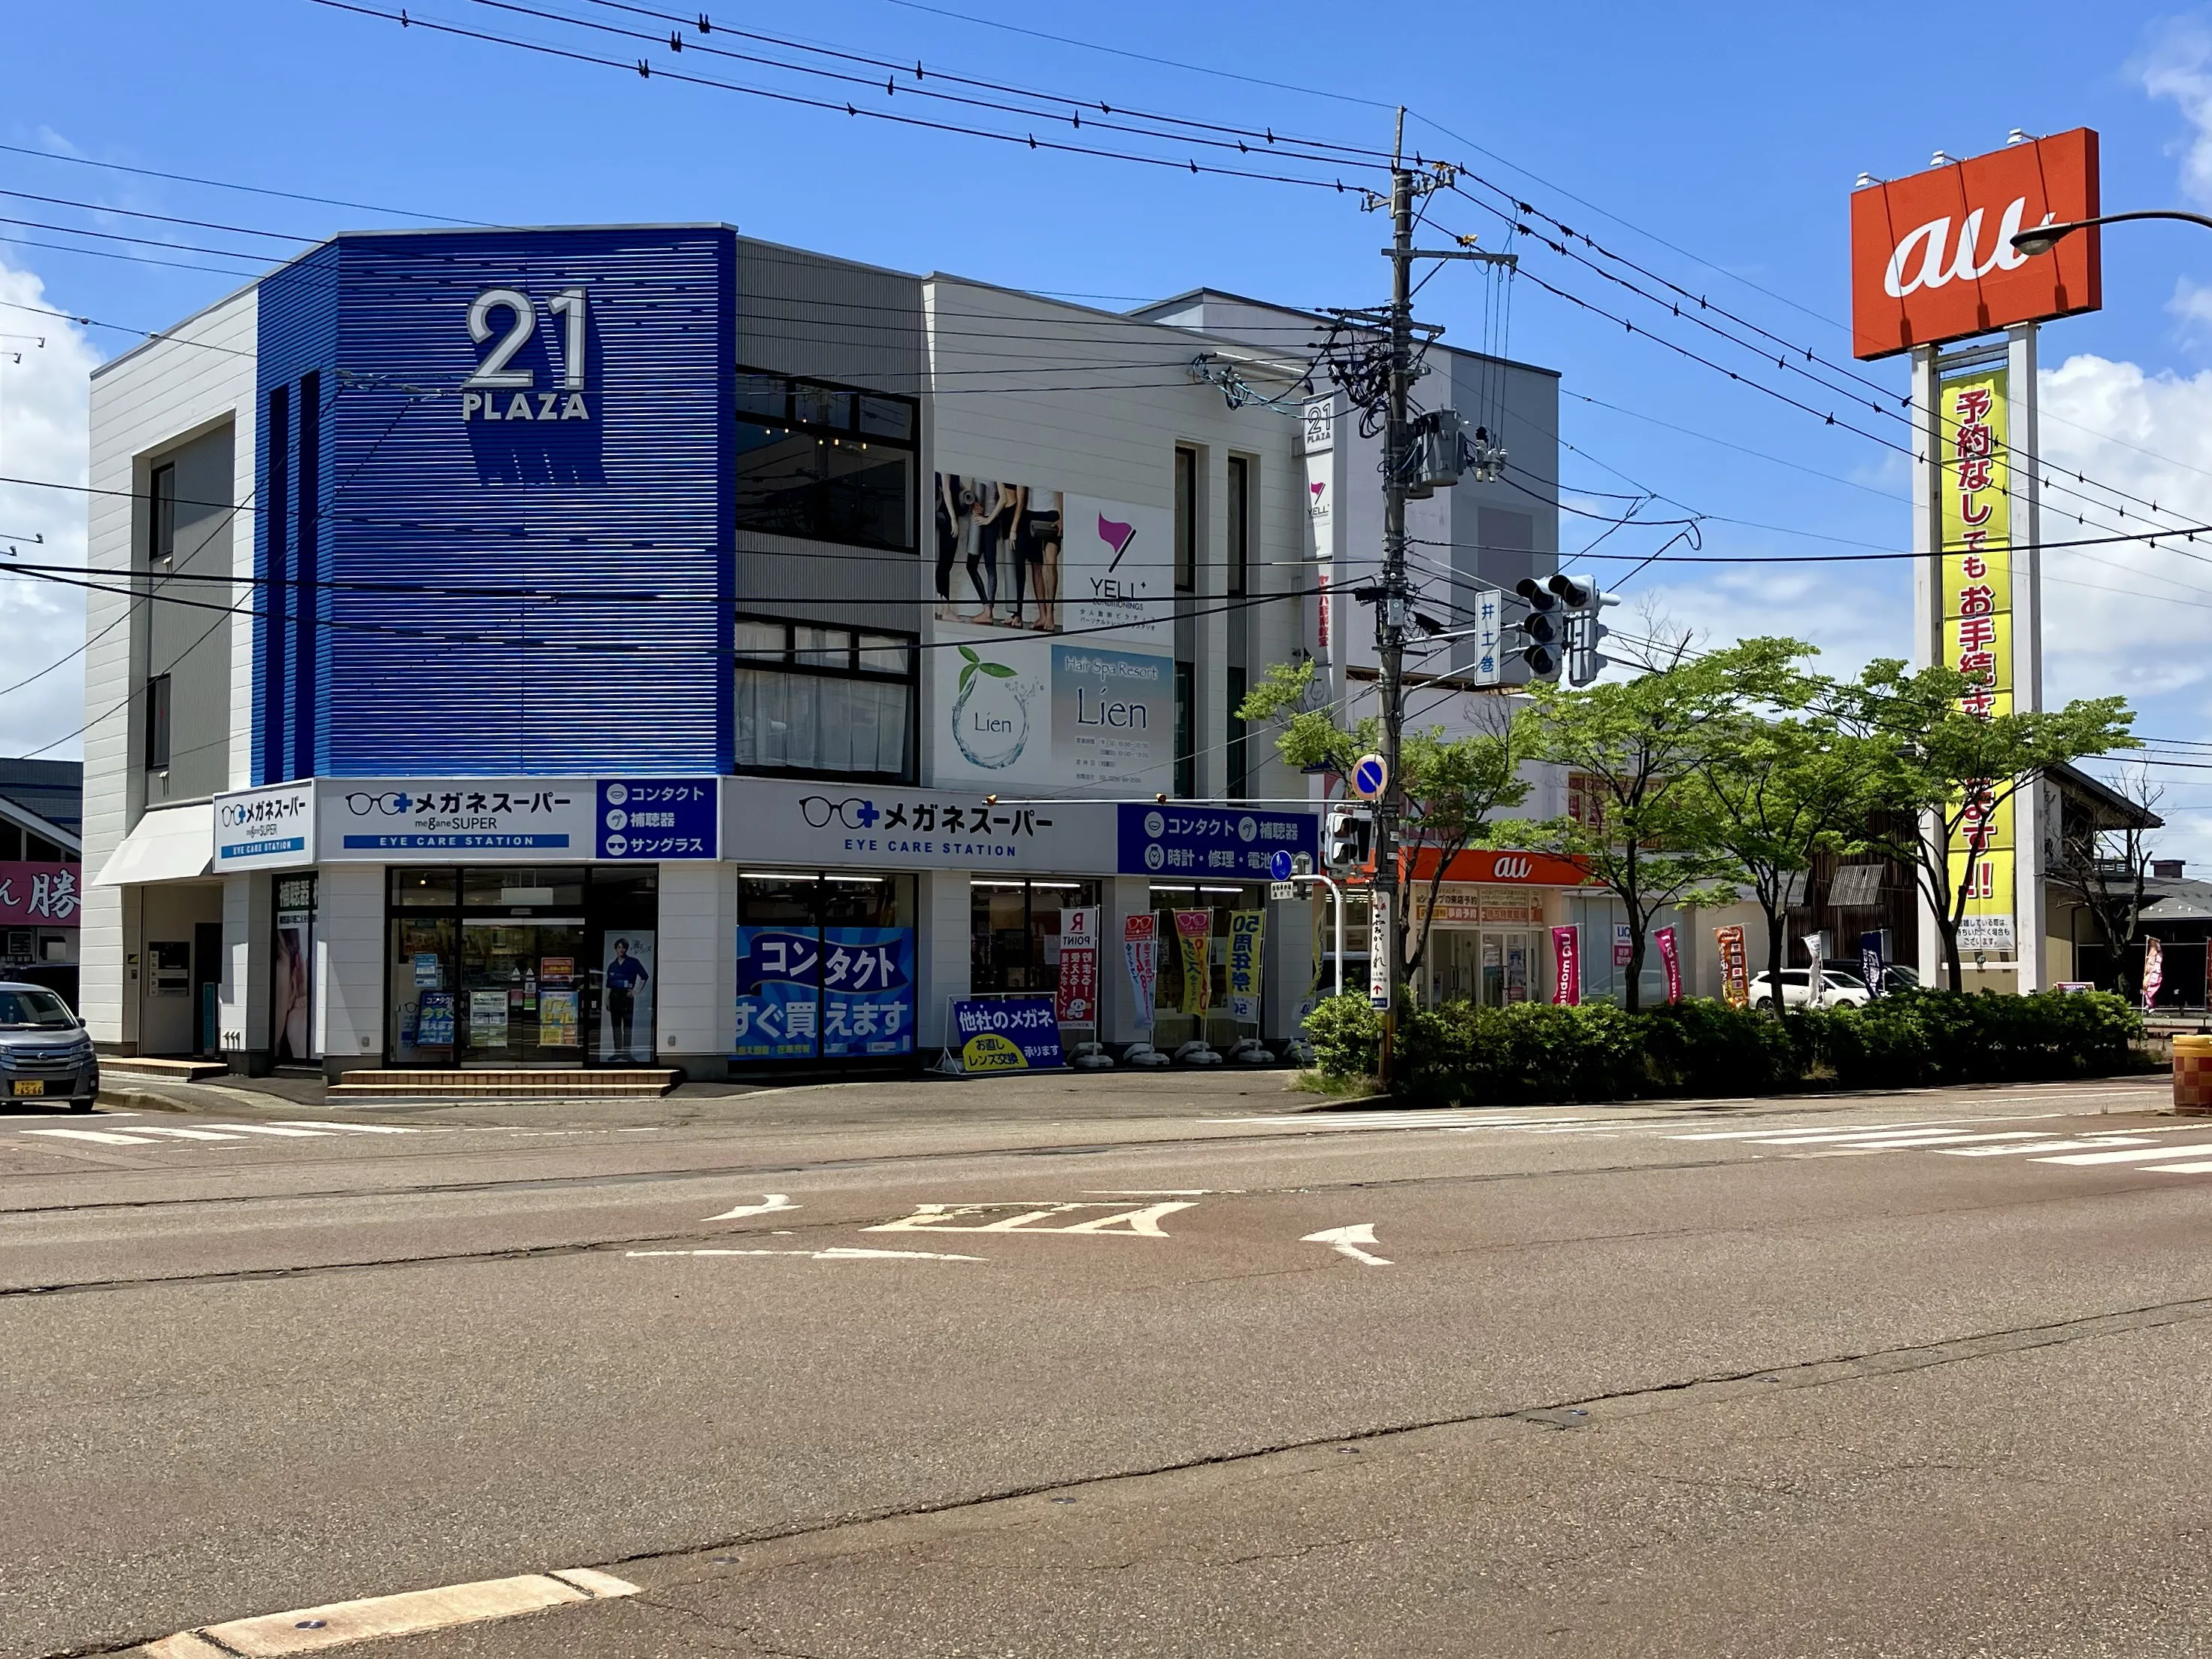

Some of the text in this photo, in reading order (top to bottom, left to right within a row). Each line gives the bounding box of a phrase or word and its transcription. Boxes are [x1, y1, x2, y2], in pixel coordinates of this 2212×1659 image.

[1883, 196, 2056, 299] au
[460, 286, 586, 390] 21
[462, 393, 589, 421] PLAZA
[1308, 403, 1331, 435] 21
[1307, 432, 1331, 444] PLAZA
[1308, 506, 1329, 517] YELL
[1480, 602, 1495, 673] 井土巻
[1065, 657, 1158, 681] Hair Spa Resort
[1077, 687, 1147, 729] Lien
[974, 711, 1012, 734] Lien
[415, 791, 571, 814] メガネスーパー
[632, 787, 705, 801] コンタクト
[247, 796, 306, 823] メガネスーパー
[630, 812, 675, 827] 補聴器
[884, 802, 1053, 837] メガネスーパー
[380, 836, 534, 846] EYE CARE STATION
[1168, 818, 1298, 841] コンタクト 補聴器
[233, 841, 292, 855] EYE CARE STATION
[630, 838, 704, 852] サングラス
[844, 839, 1016, 857] EYE CARE STATION
[1493, 856, 1532, 879] au
[1617, 927, 1631, 937] UQ
[762, 941, 895, 989] コンタクト
[736, 1001, 908, 1039] すぐ買えます
[959, 1008, 1054, 1032] 他社のメガネ
[975, 1038, 1005, 1051] お直し
[1023, 1045, 1059, 1057] 承ります
[968, 1051, 1020, 1067] レンズ交換
